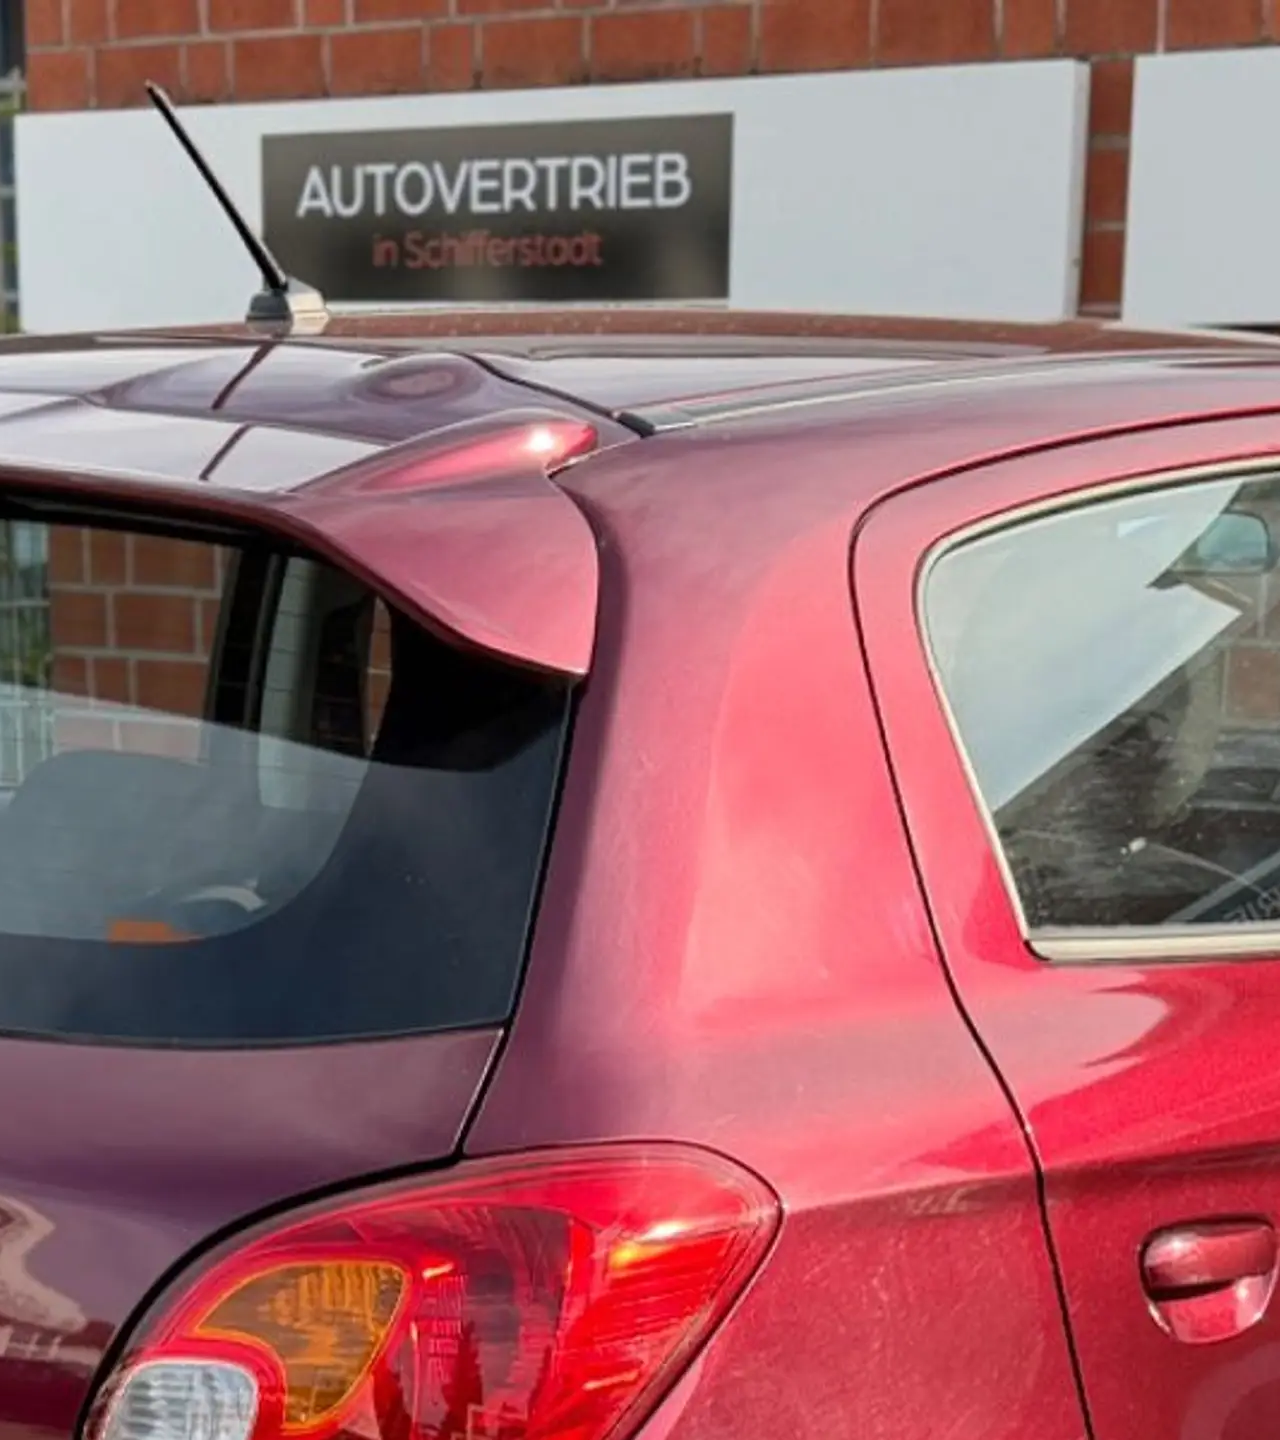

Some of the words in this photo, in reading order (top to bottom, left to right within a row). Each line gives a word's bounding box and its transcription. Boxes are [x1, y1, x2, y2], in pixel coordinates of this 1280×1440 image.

[296, 152, 691, 218] AUTOVERTRIEB
[371, 234, 398, 267] in
[402, 228, 603, 269] Schifferstadt
